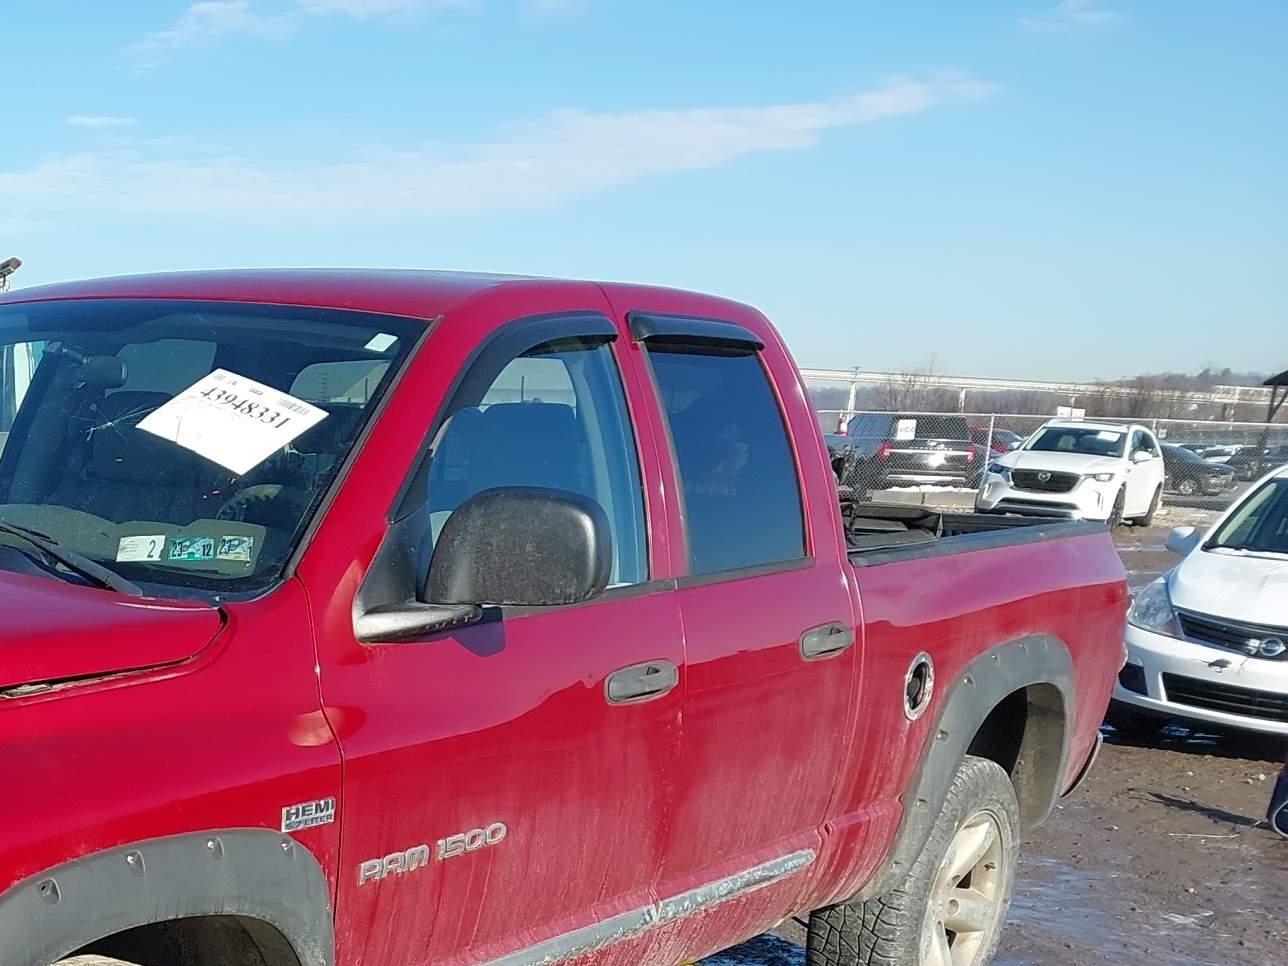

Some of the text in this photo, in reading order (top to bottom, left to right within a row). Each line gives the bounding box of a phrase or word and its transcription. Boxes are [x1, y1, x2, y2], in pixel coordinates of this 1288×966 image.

[199, 385, 291, 429] 43948331
[146, 539, 157, 559] 2
[171, 540, 183, 558] 23
[202, 543, 212, 557] 12
[285, 799, 336, 821] HEMI
[357, 822, 508, 885] RAM 1500
